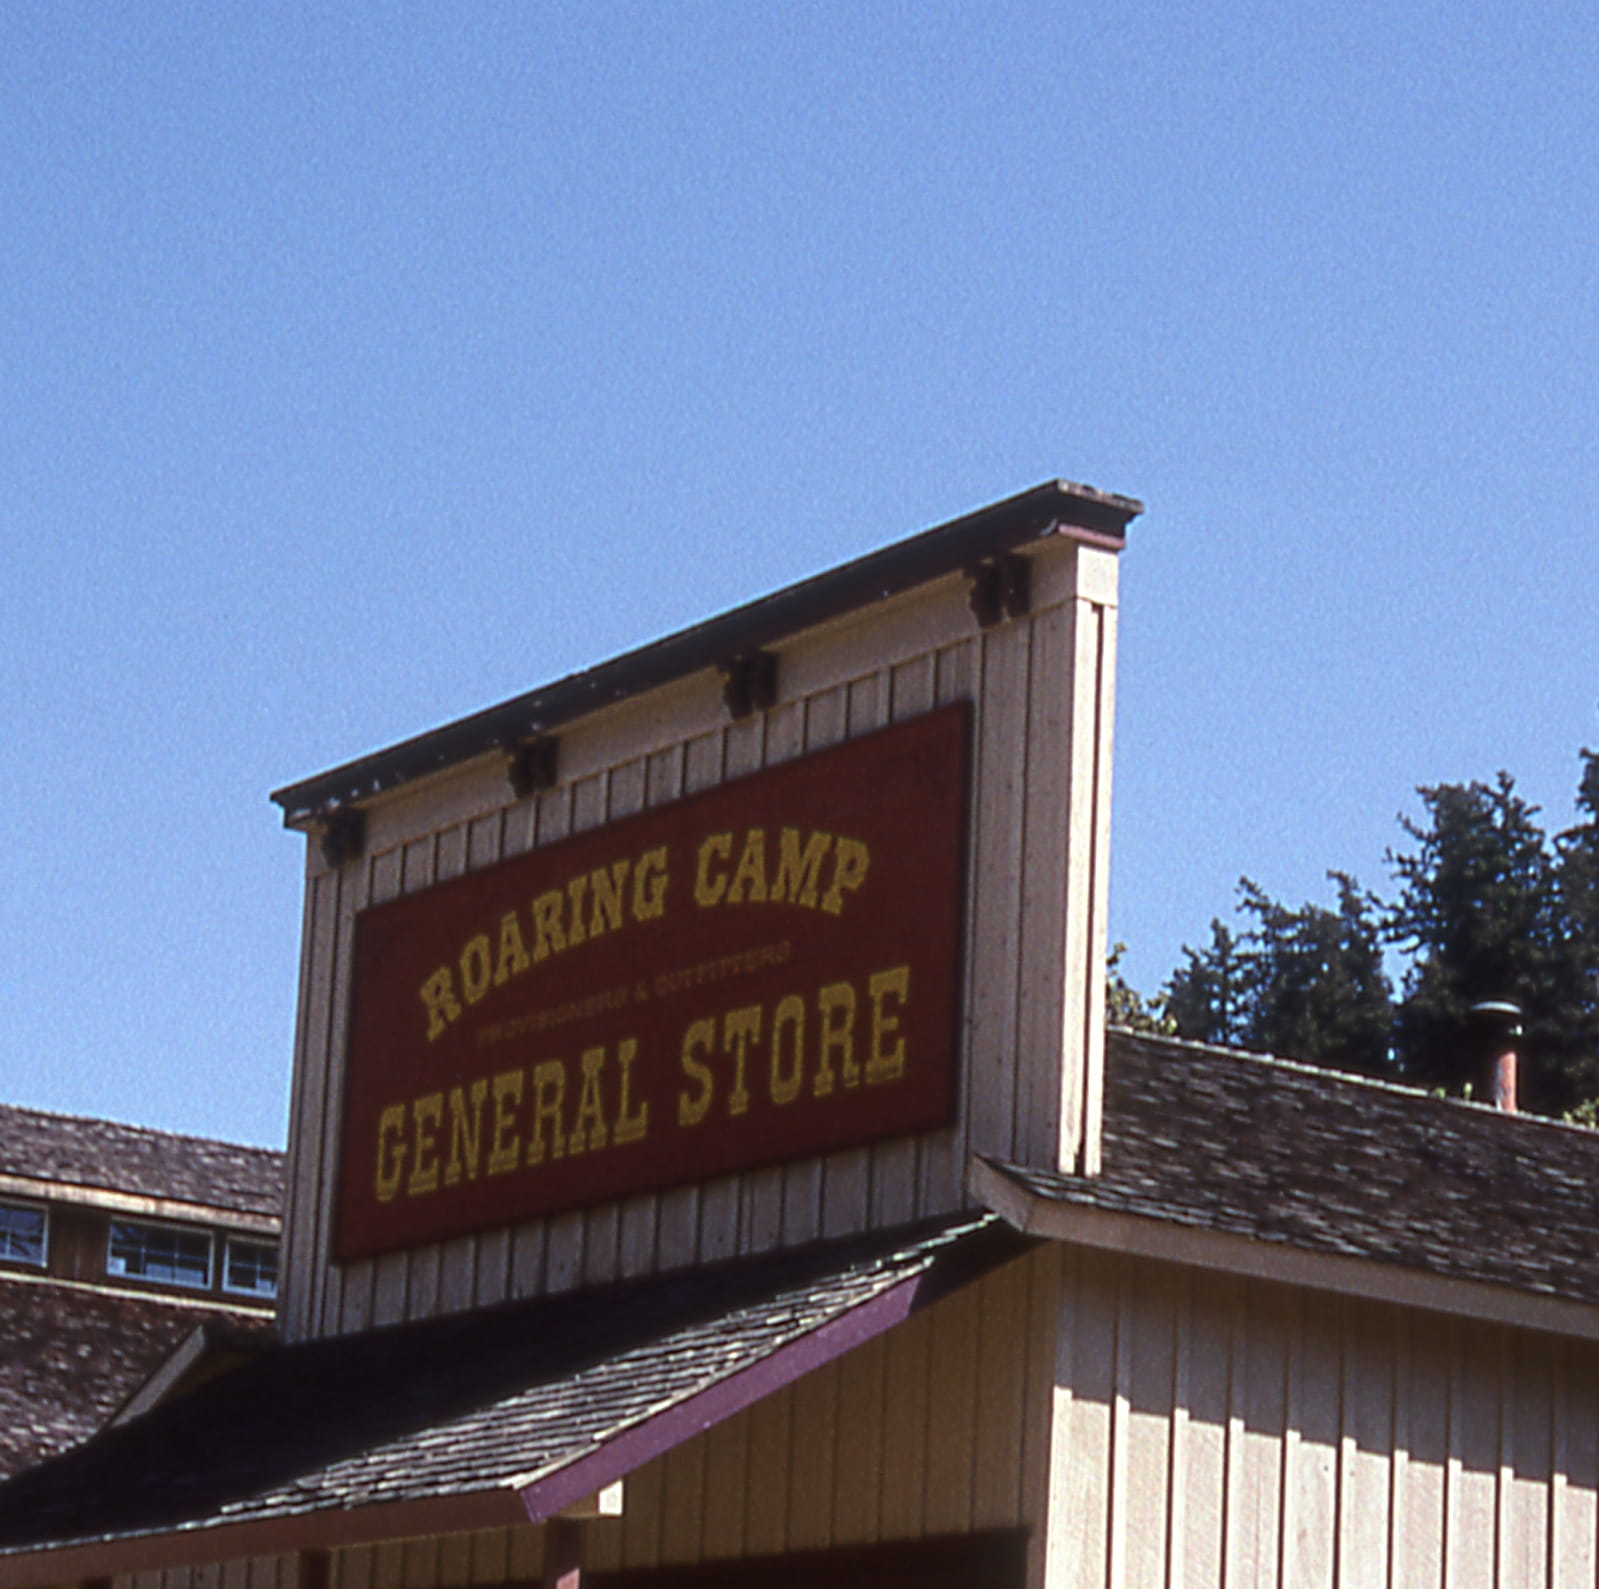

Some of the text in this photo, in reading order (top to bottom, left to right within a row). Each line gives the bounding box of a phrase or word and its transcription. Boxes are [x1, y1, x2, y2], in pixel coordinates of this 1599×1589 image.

[419, 828, 870, 1041] ROARING CAMP
[375, 966, 909, 1201] GENERAL STORE
